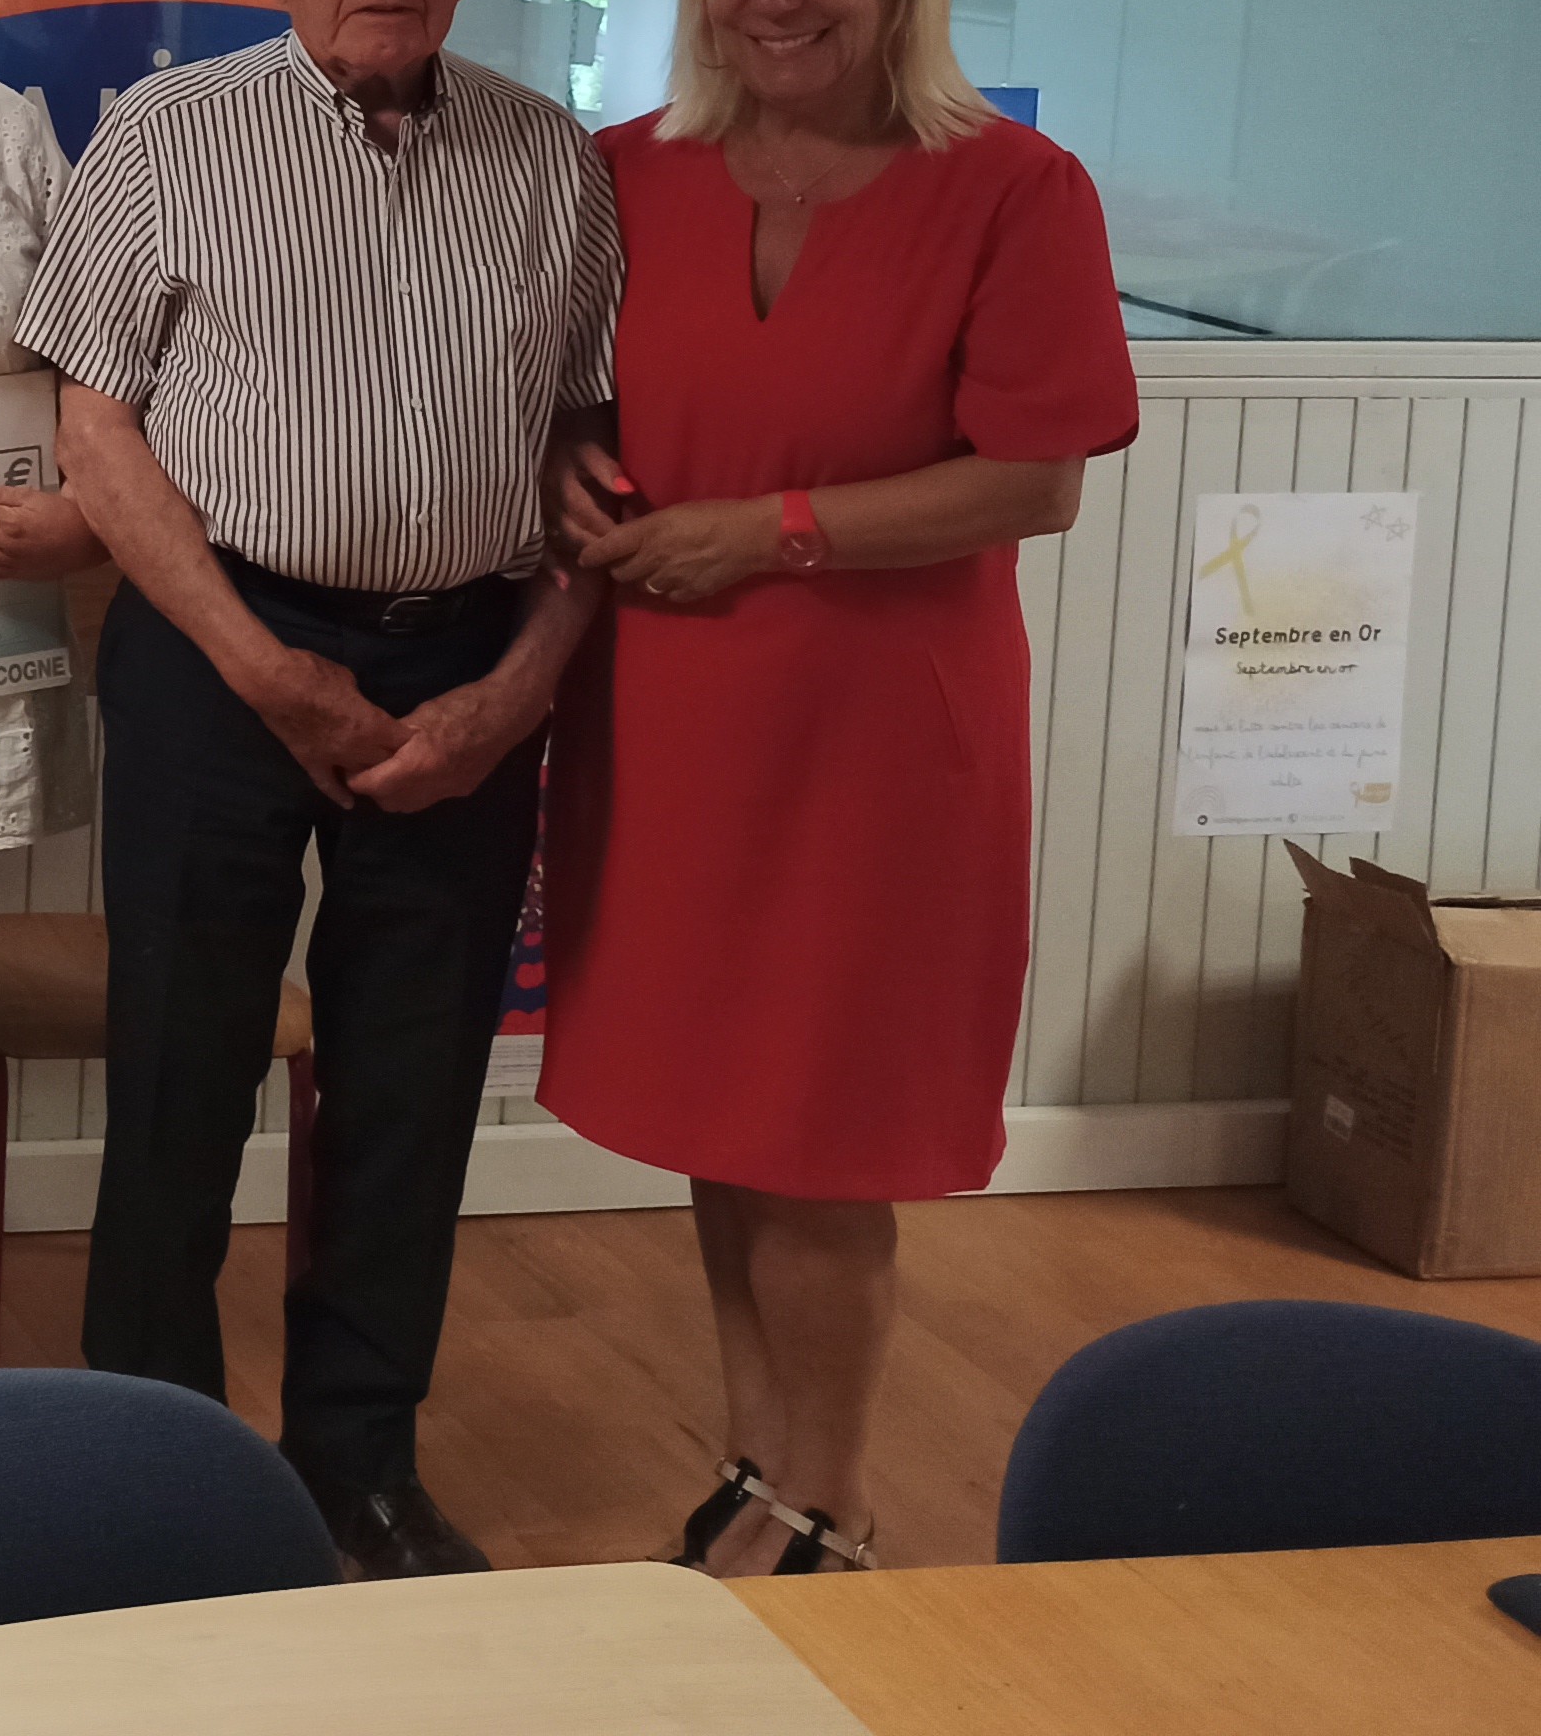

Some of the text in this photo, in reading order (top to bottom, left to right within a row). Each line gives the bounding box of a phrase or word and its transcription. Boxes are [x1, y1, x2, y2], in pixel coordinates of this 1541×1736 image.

[1214, 623, 1382, 649] Septembre en Or
